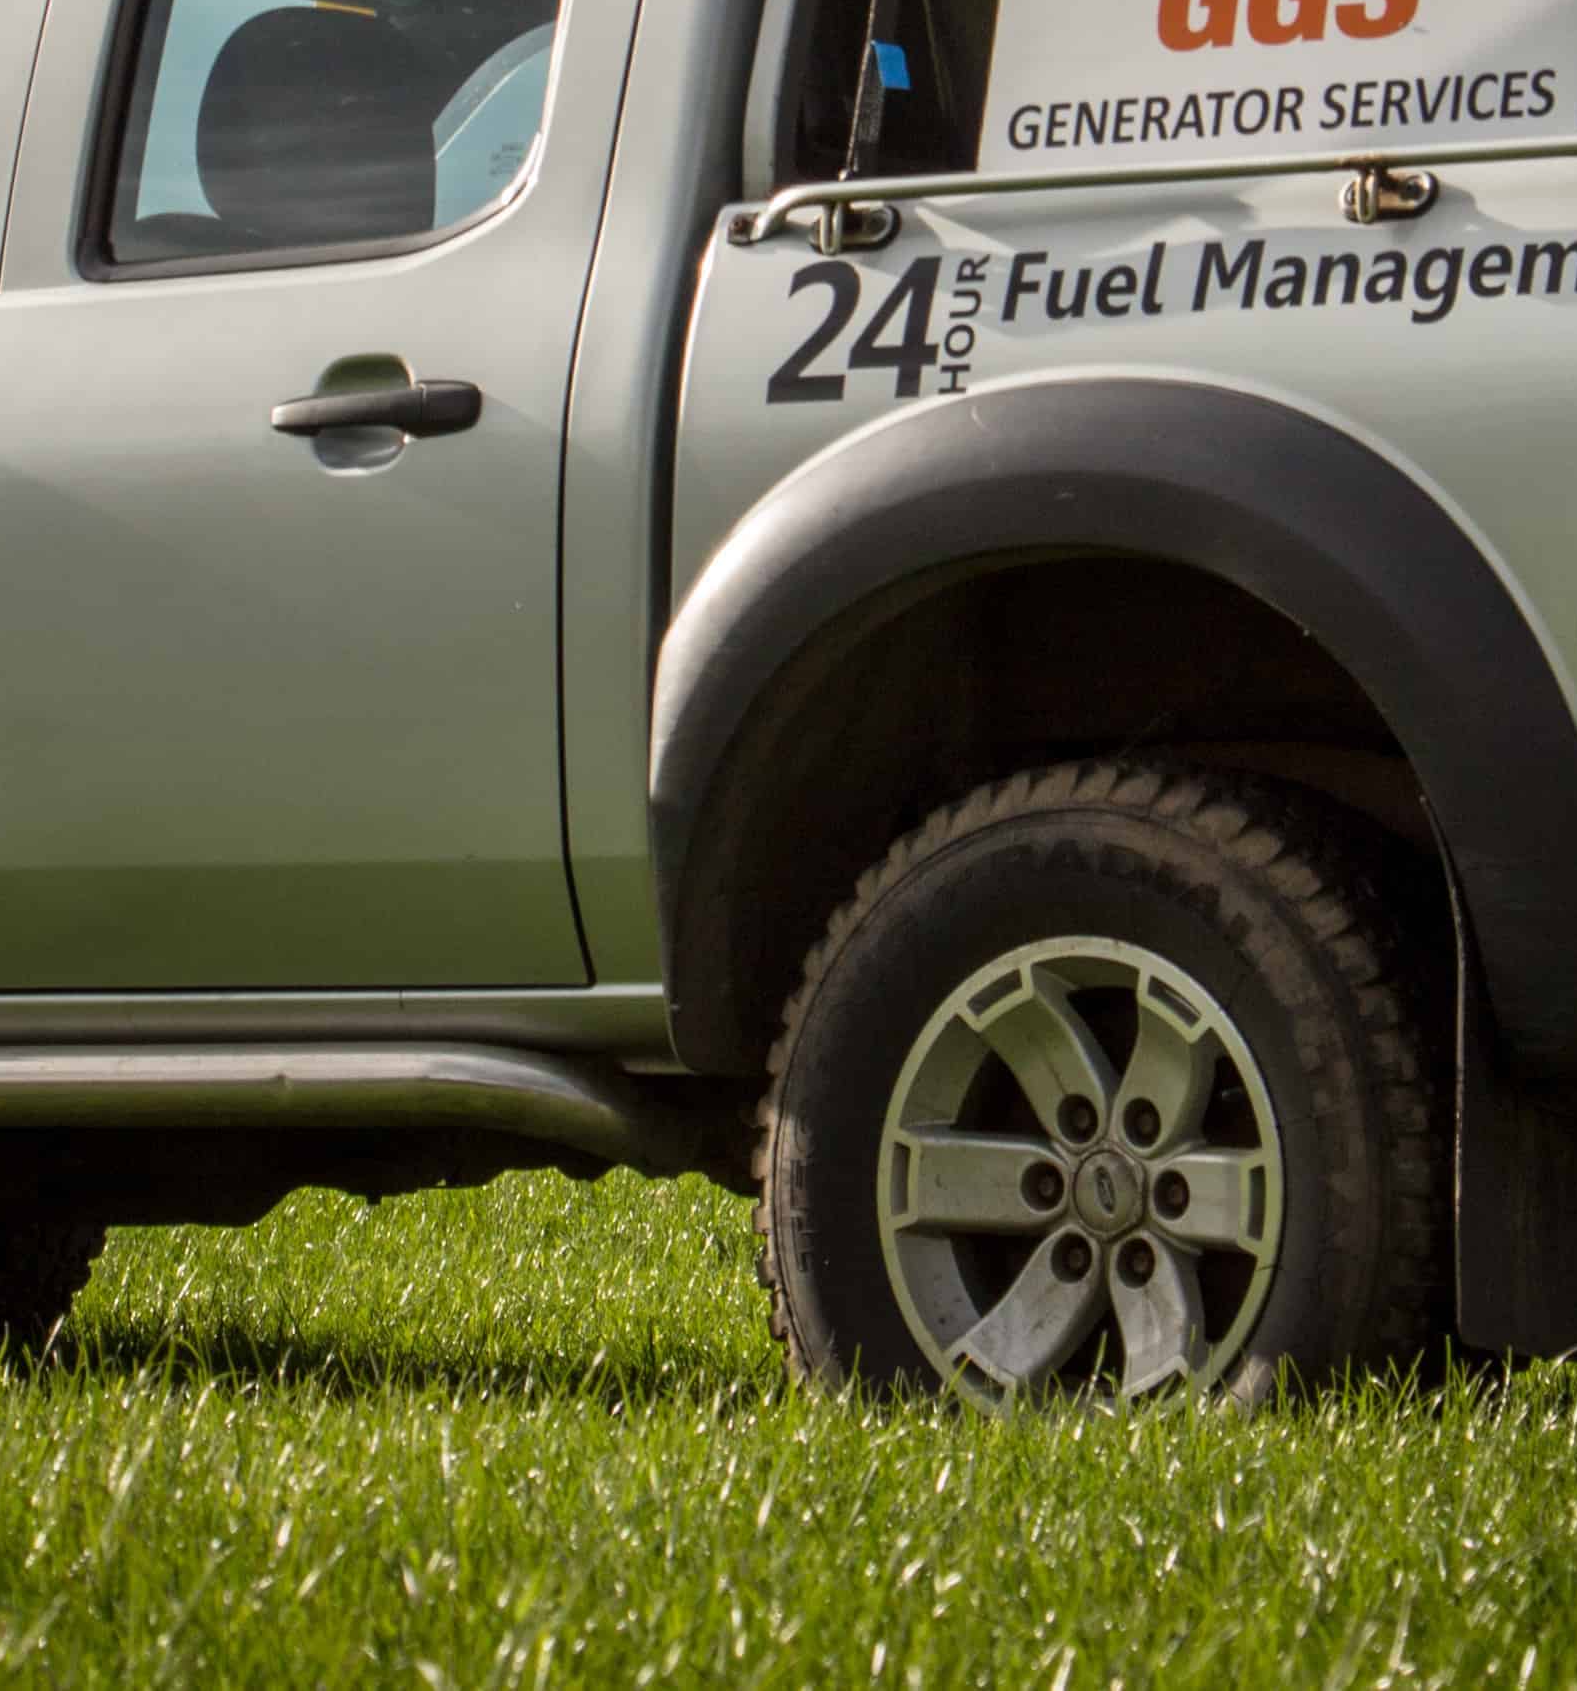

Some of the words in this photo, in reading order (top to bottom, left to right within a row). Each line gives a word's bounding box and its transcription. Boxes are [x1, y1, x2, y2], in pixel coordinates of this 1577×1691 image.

[1007, 85, 1304, 152] GENERATOR
[1318, 68, 1556, 130] SERVICES
[766, 255, 943, 405] 24
[937, 253, 991, 395] HOUR
[1000, 241, 1167, 322] Fuel
